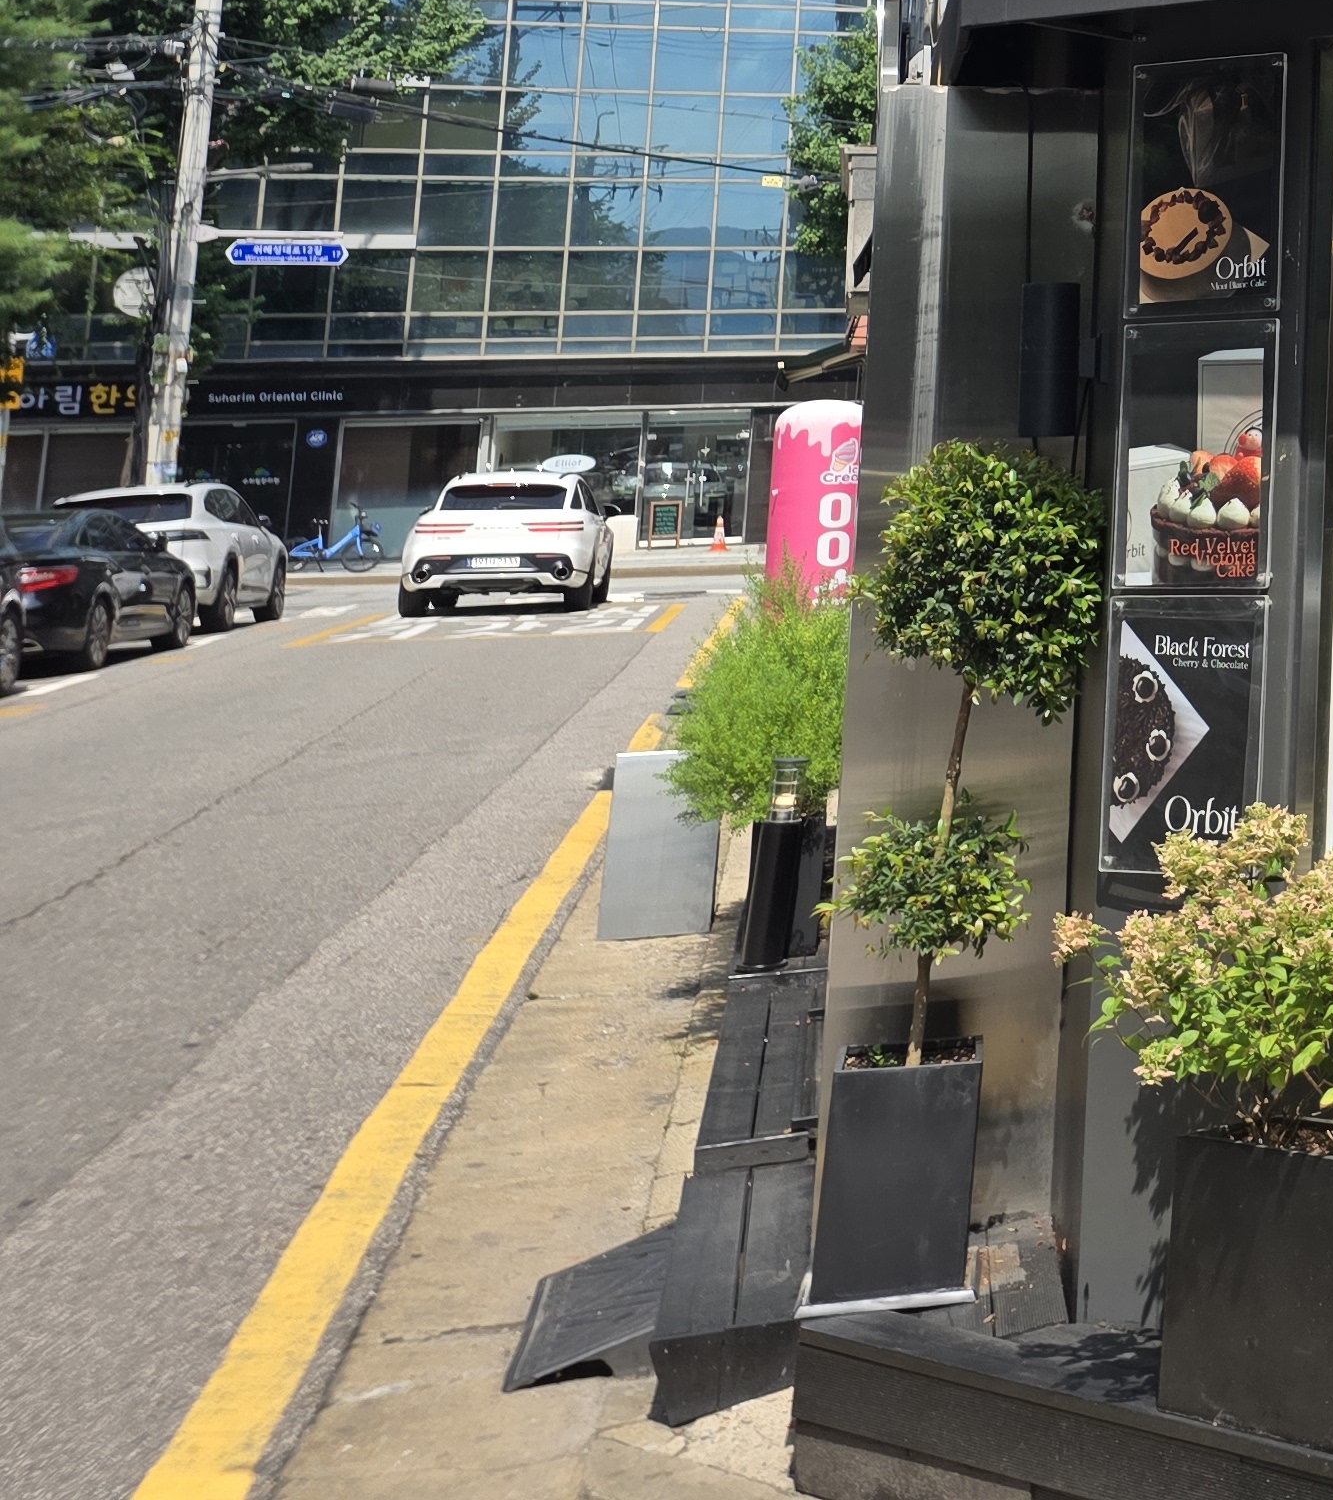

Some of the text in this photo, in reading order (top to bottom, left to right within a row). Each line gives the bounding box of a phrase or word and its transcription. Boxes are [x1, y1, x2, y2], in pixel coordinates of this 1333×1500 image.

[1215, 254, 1267, 280] Orbit
[259, 391, 307, 402] Oriental
[1170, 536, 1256, 556] Red Velvet
[1194, 549, 1256, 566] Victoria
[1215, 562, 1255, 578] Cake
[1154, 634, 1250, 659] Black Forest
[1172, 657, 1249, 670] Cherry & Chocolate
[1164, 795, 1239, 836] Orbit
